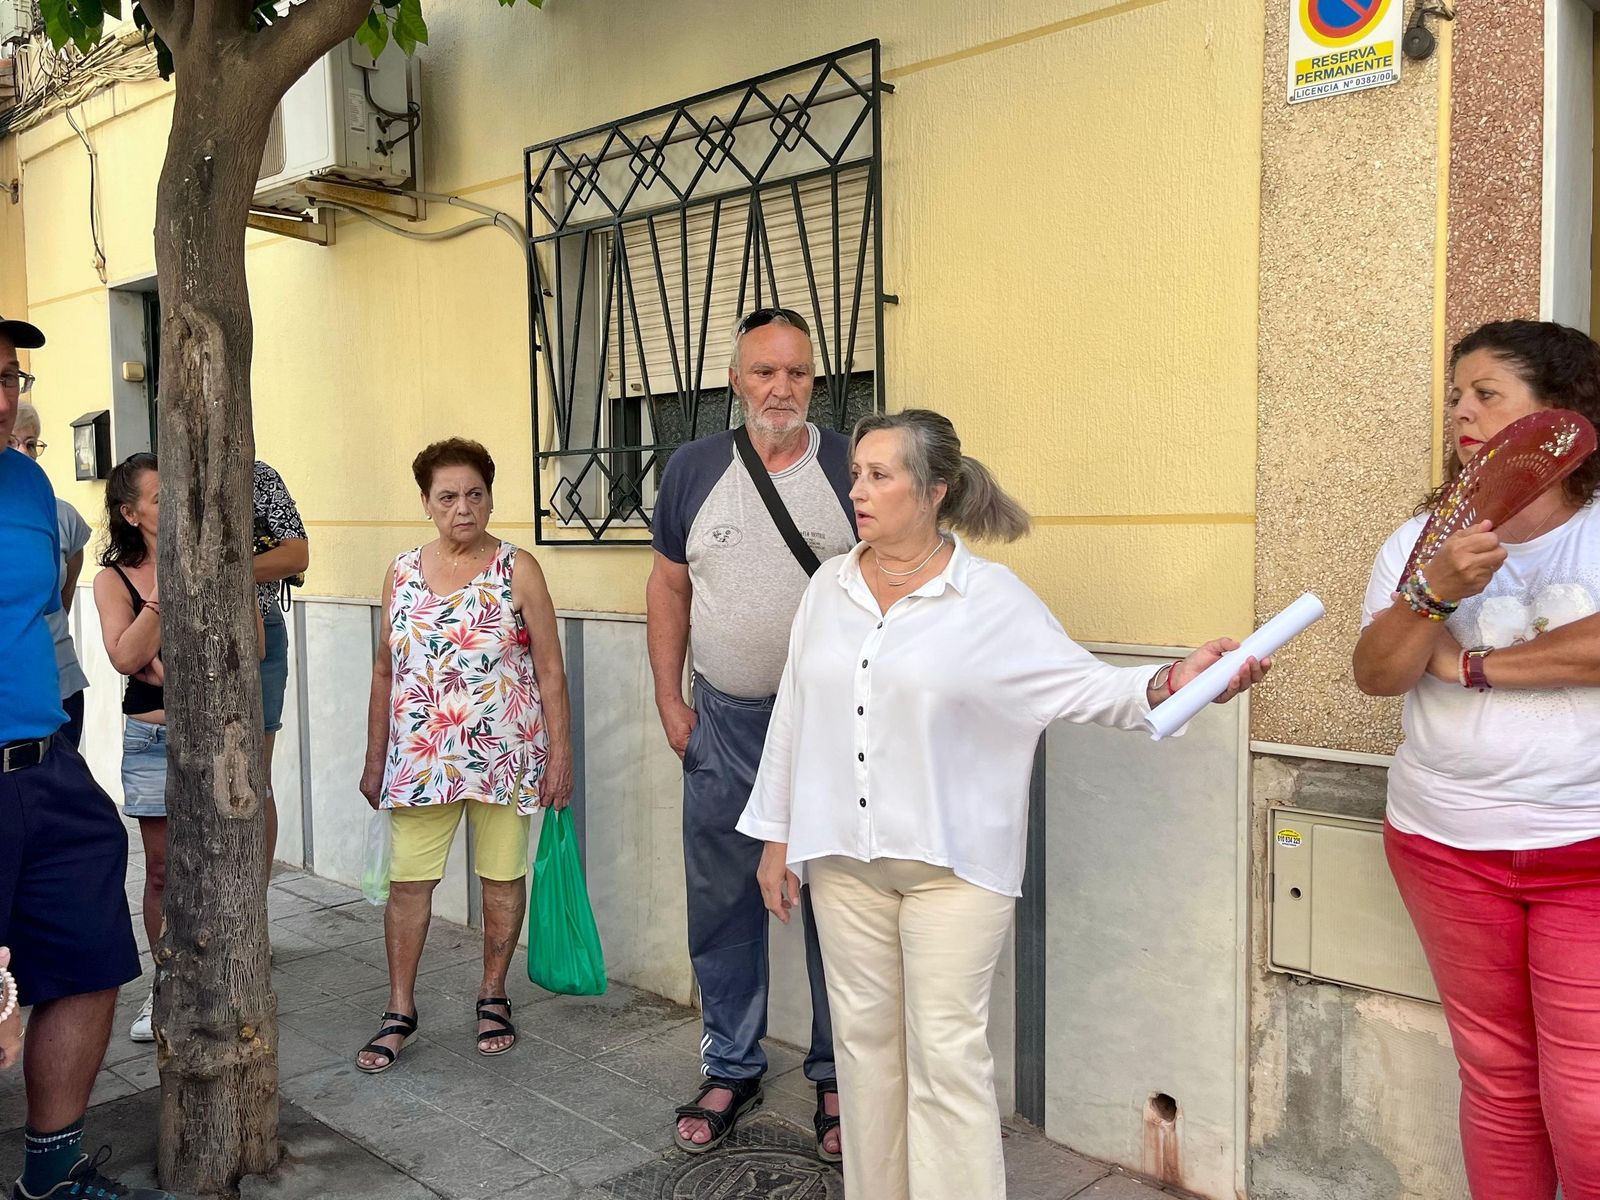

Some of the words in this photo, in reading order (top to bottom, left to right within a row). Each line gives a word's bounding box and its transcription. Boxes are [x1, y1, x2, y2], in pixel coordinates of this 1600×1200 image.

[1296, 55, 1392, 85] PERMANENTE
[1311, 46, 1376, 69] RESERVA
[1296, 83, 1339, 98] LICENCIA
[1343, 80, 1354, 88] Nº
[1355, 73, 1391, 86] 0382/00
